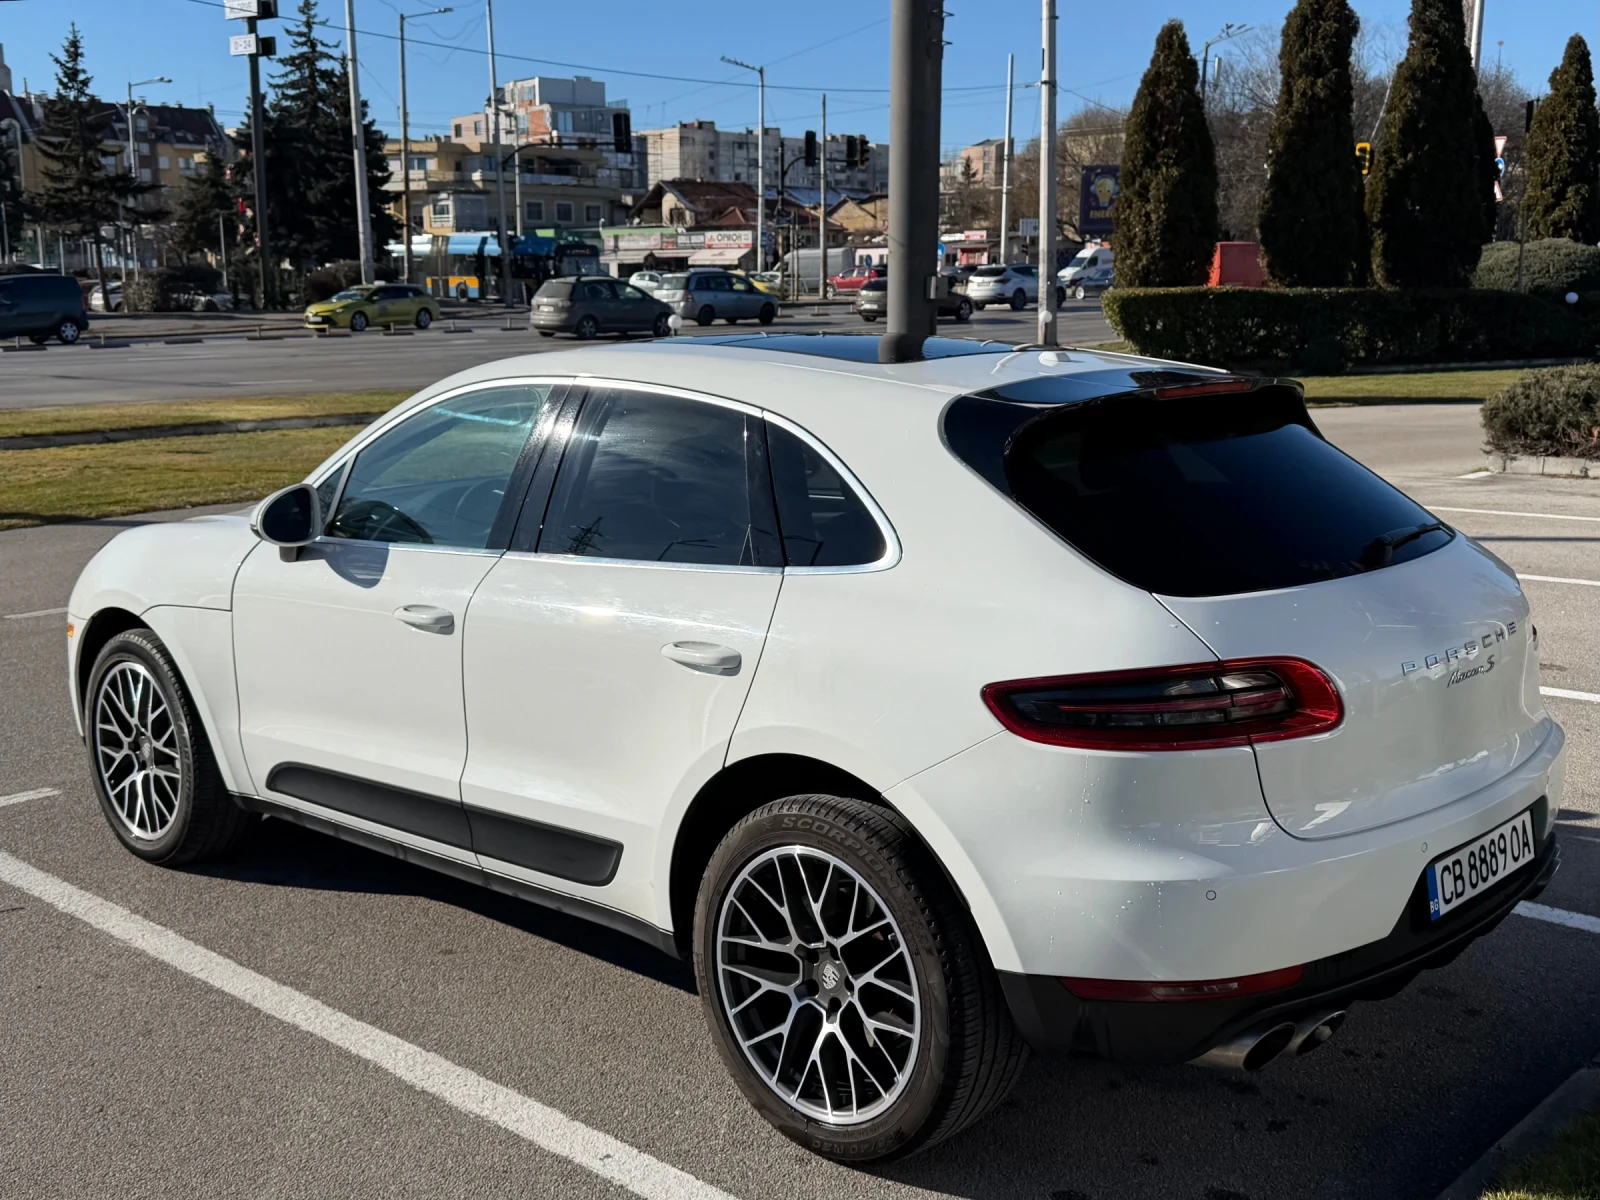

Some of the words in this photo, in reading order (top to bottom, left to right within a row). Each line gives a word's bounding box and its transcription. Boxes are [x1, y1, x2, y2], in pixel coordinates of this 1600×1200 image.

[1401, 621, 1517, 677] PORSCHE
[1446, 663, 1486, 689] Macan
[1485, 654, 1496, 674] S
[781, 815, 901, 890] SCORPION
[1440, 857, 1467, 906] CB
[1467, 831, 1508, 891] 8889
[1429, 898, 1440, 914] BG
